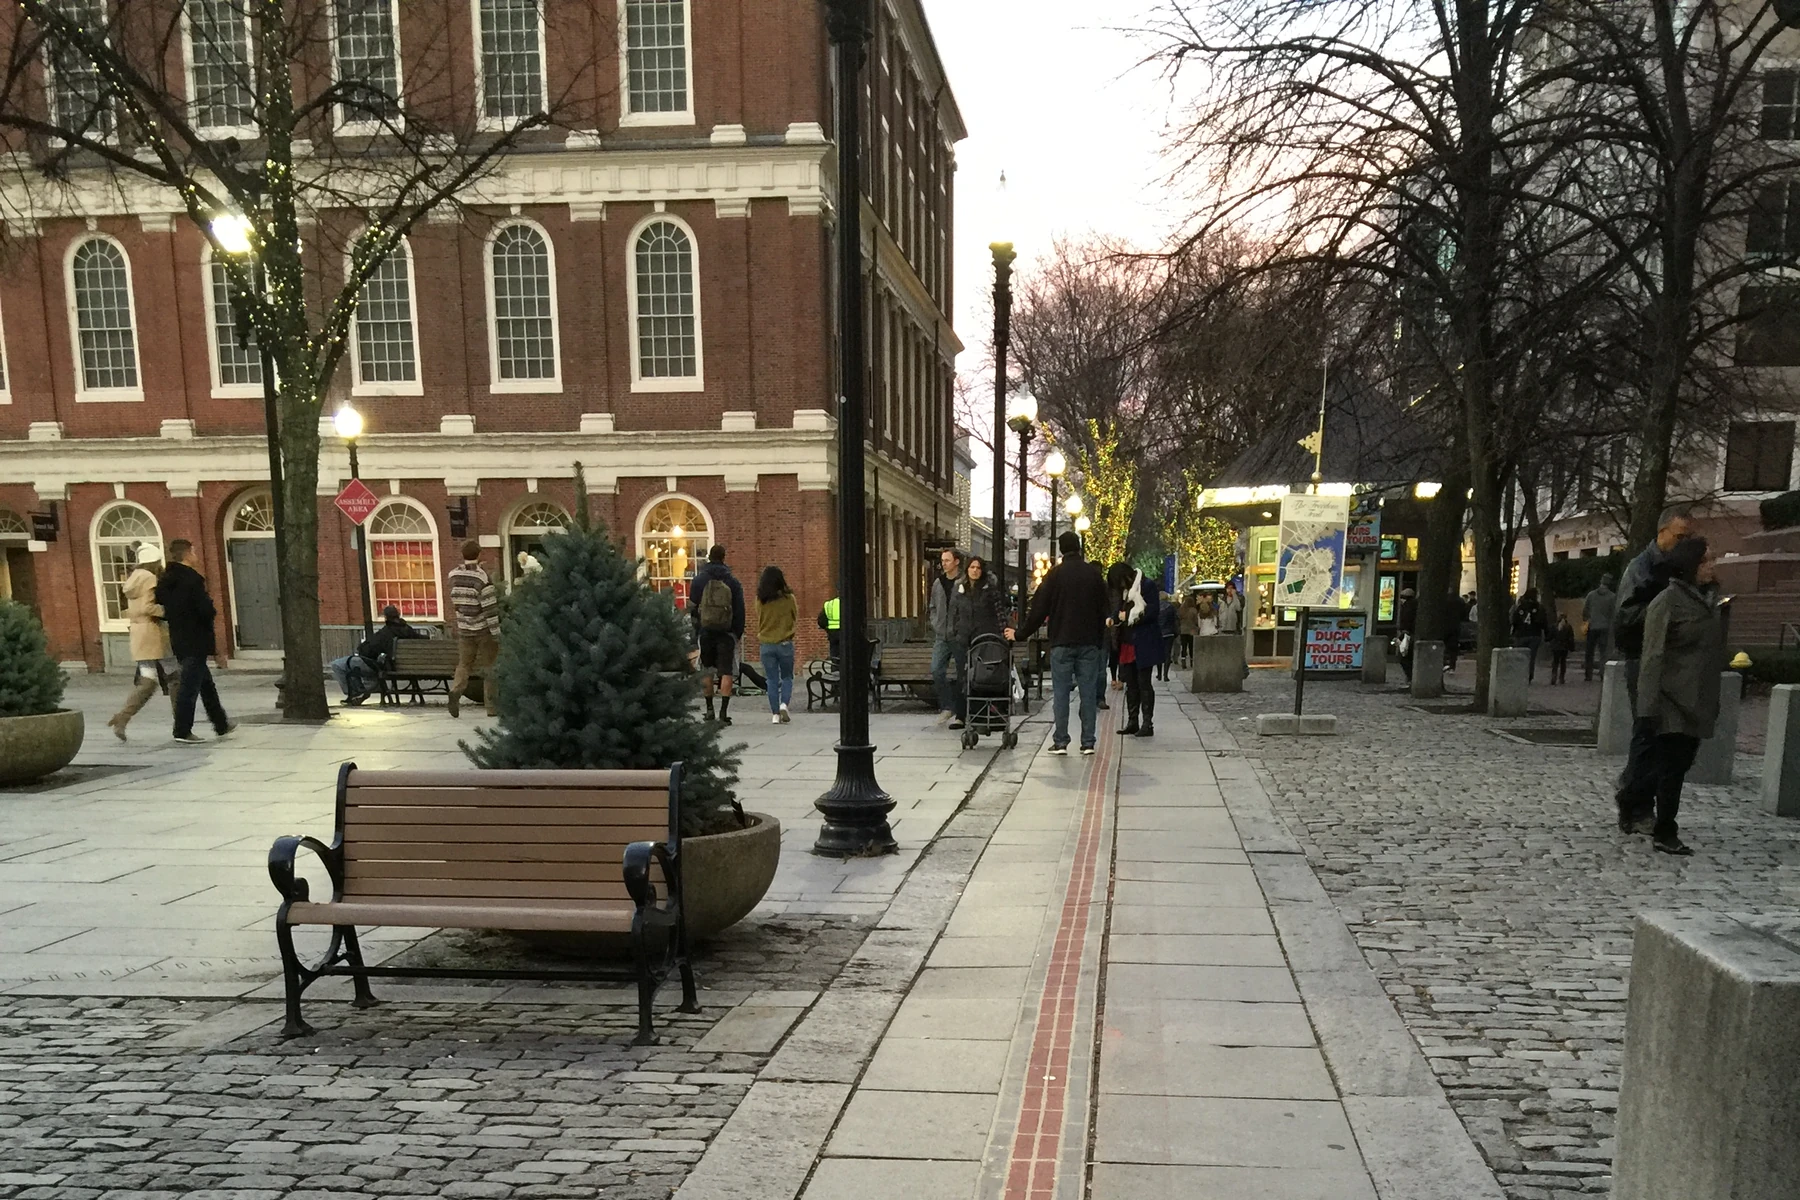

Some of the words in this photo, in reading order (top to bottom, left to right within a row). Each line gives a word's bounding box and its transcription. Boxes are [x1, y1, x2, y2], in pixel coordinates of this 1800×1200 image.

[1347, 536, 1378, 545] TOURS
[1315, 630, 1351, 641] DUCK
[1306, 643, 1361, 653] TROLLEY
[1311, 654, 1353, 664] TOURS
